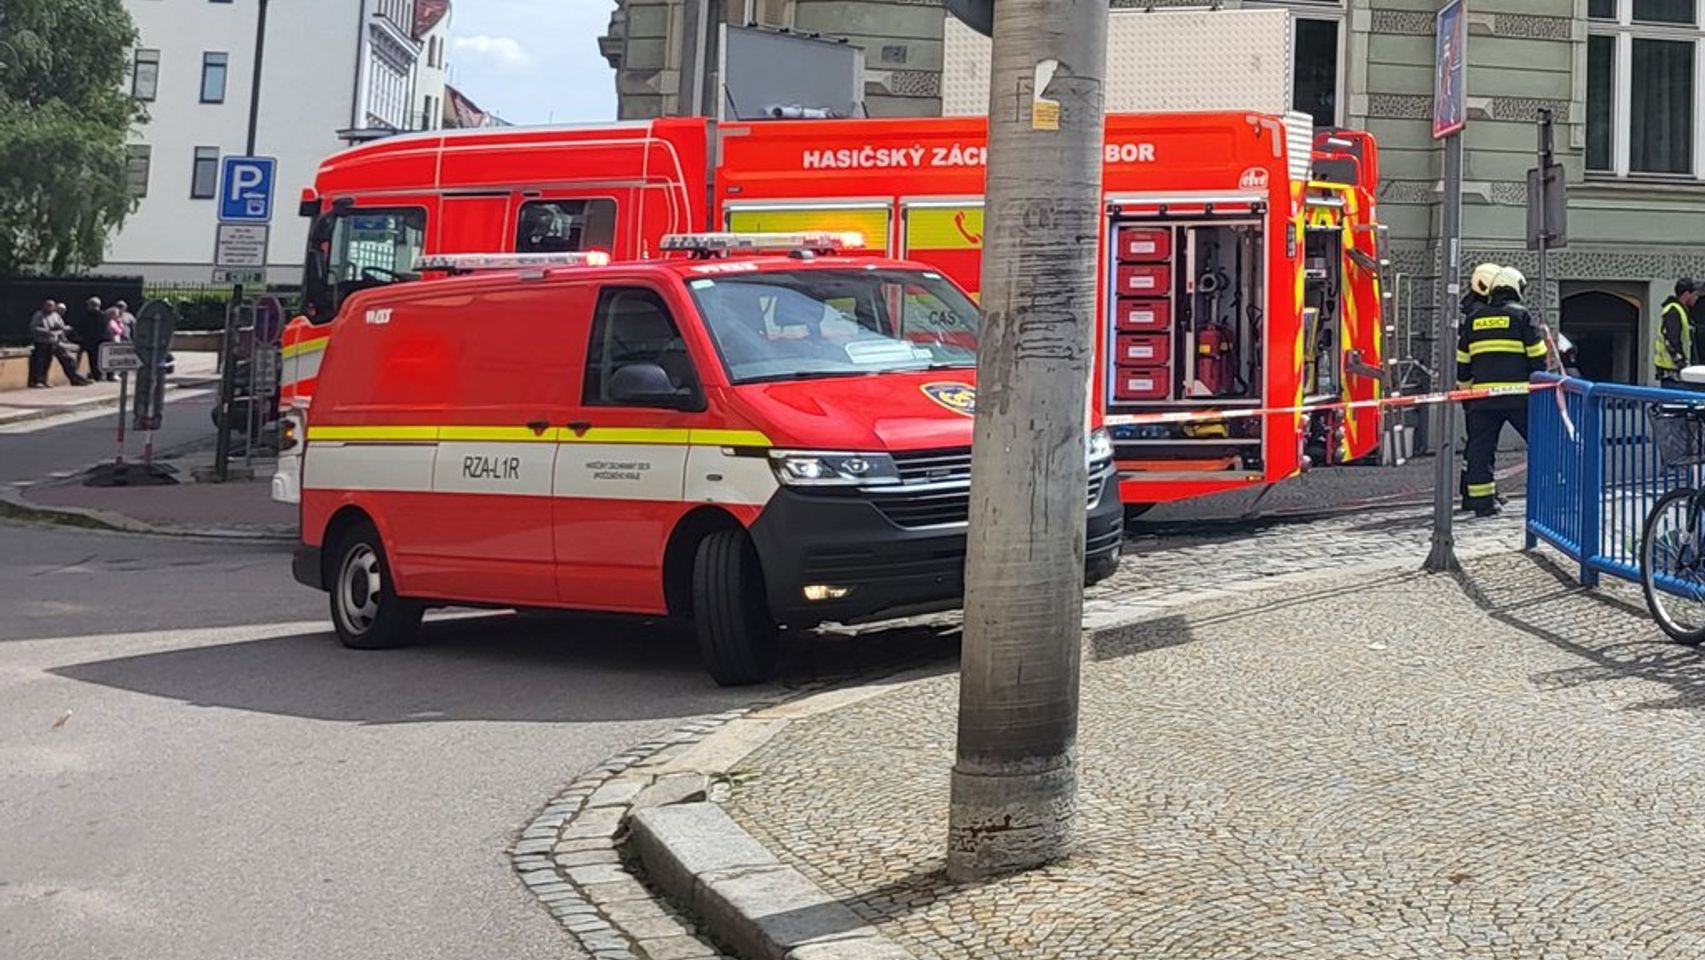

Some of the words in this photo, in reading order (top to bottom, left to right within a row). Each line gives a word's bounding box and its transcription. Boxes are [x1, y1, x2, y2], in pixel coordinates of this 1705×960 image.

[803, 145, 924, 168] HASIČSKÝ
[1105, 144, 1155, 162] BOR
[929, 310, 957, 326] CAS
